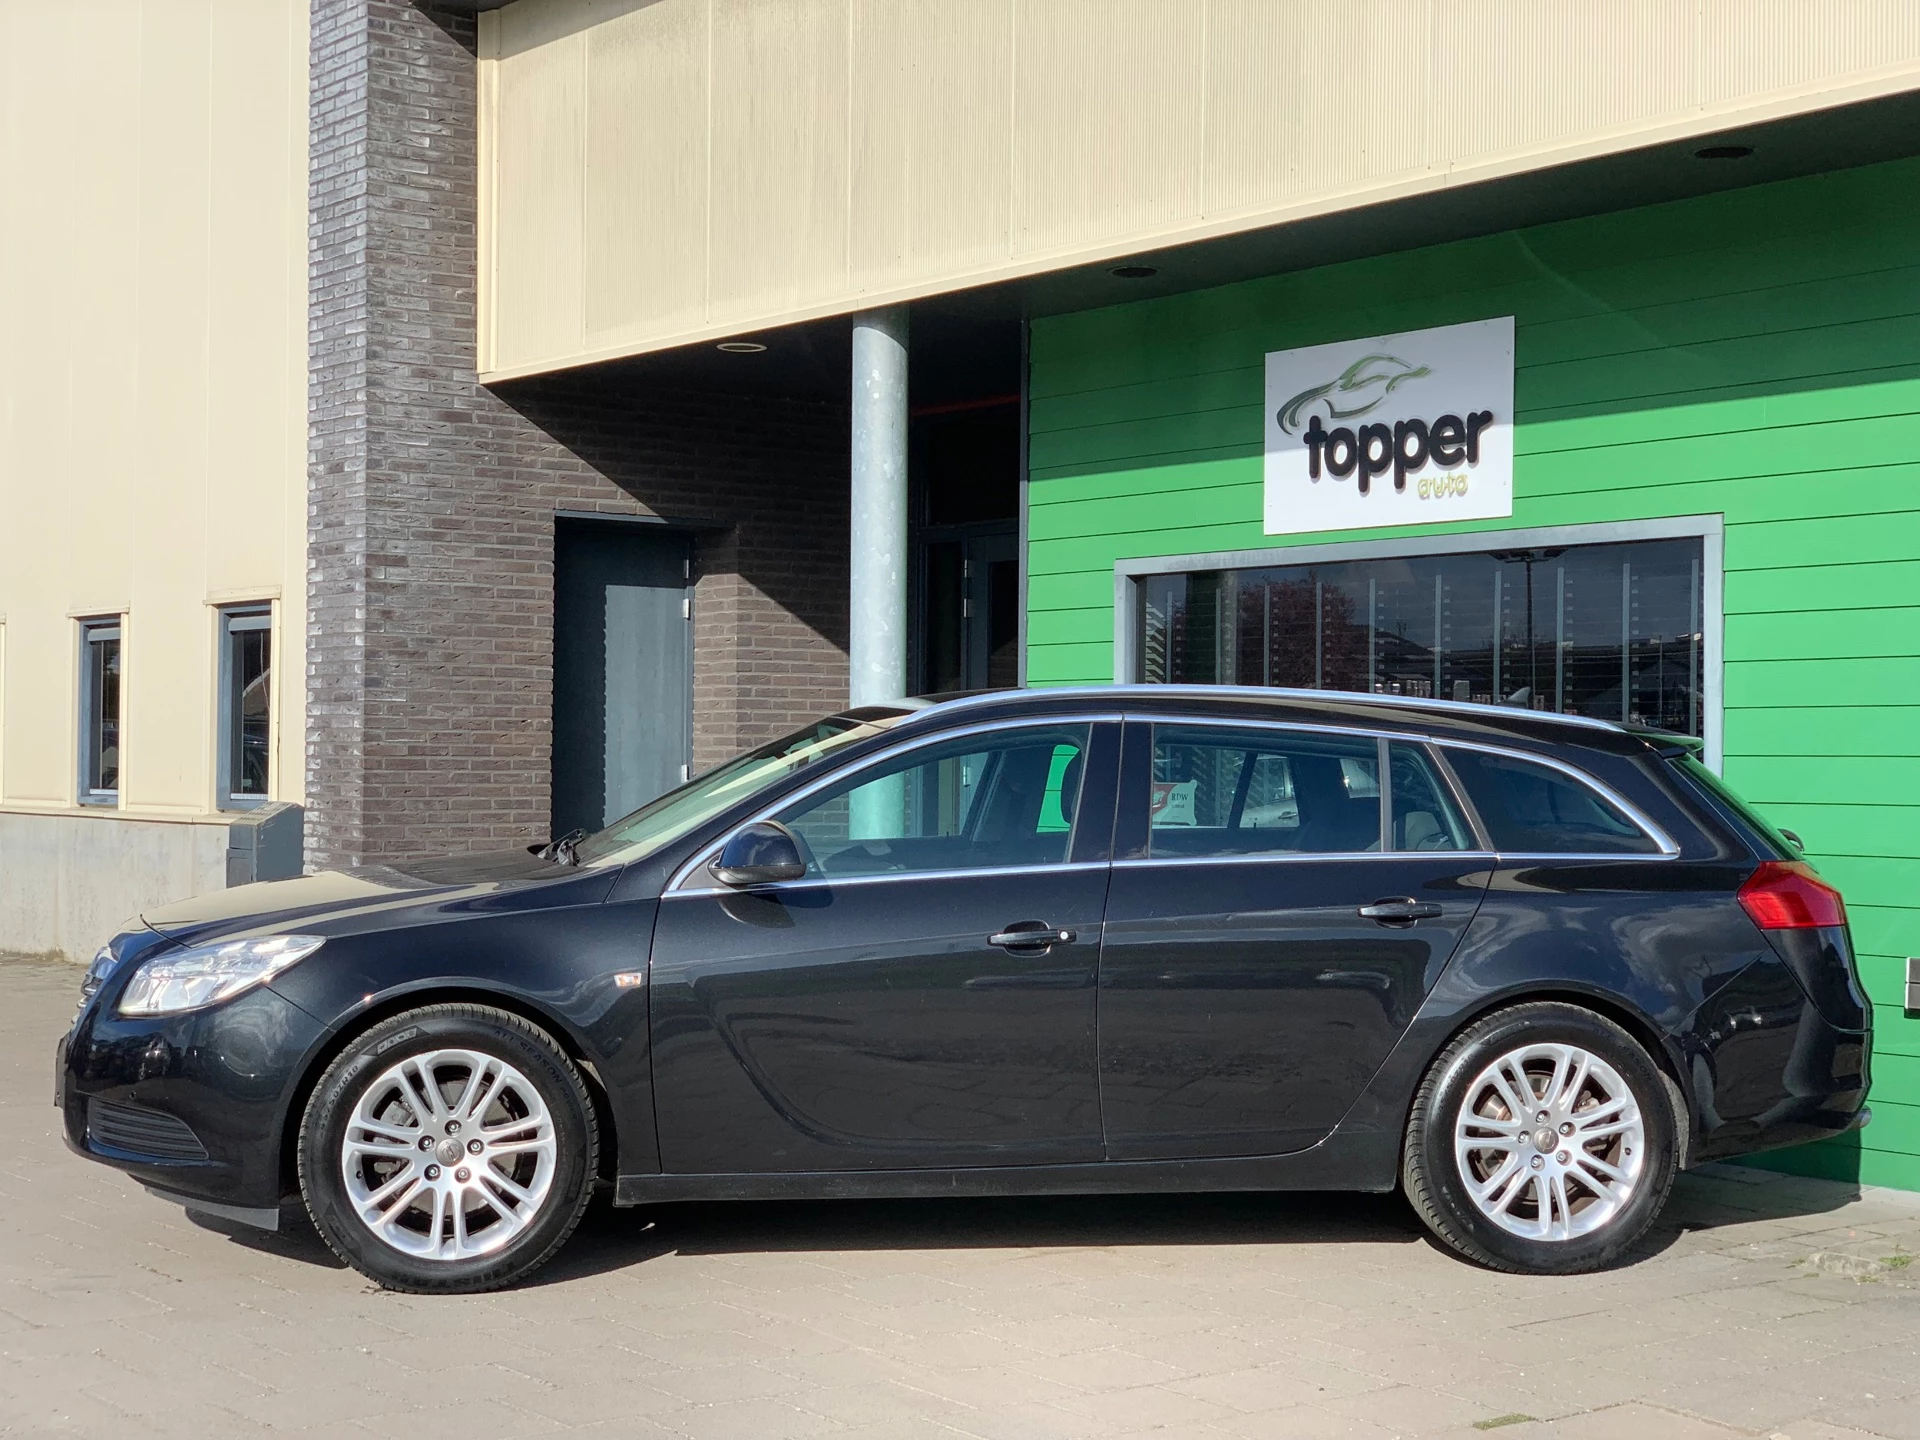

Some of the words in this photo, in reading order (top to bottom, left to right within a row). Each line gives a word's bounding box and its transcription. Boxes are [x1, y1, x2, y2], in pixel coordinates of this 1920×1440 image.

[1303, 410, 1494, 493] topper
[1417, 472, 1468, 499] auto
[1171, 792, 1189, 801] RDW
[520, 1041, 562, 1083] SEASON
